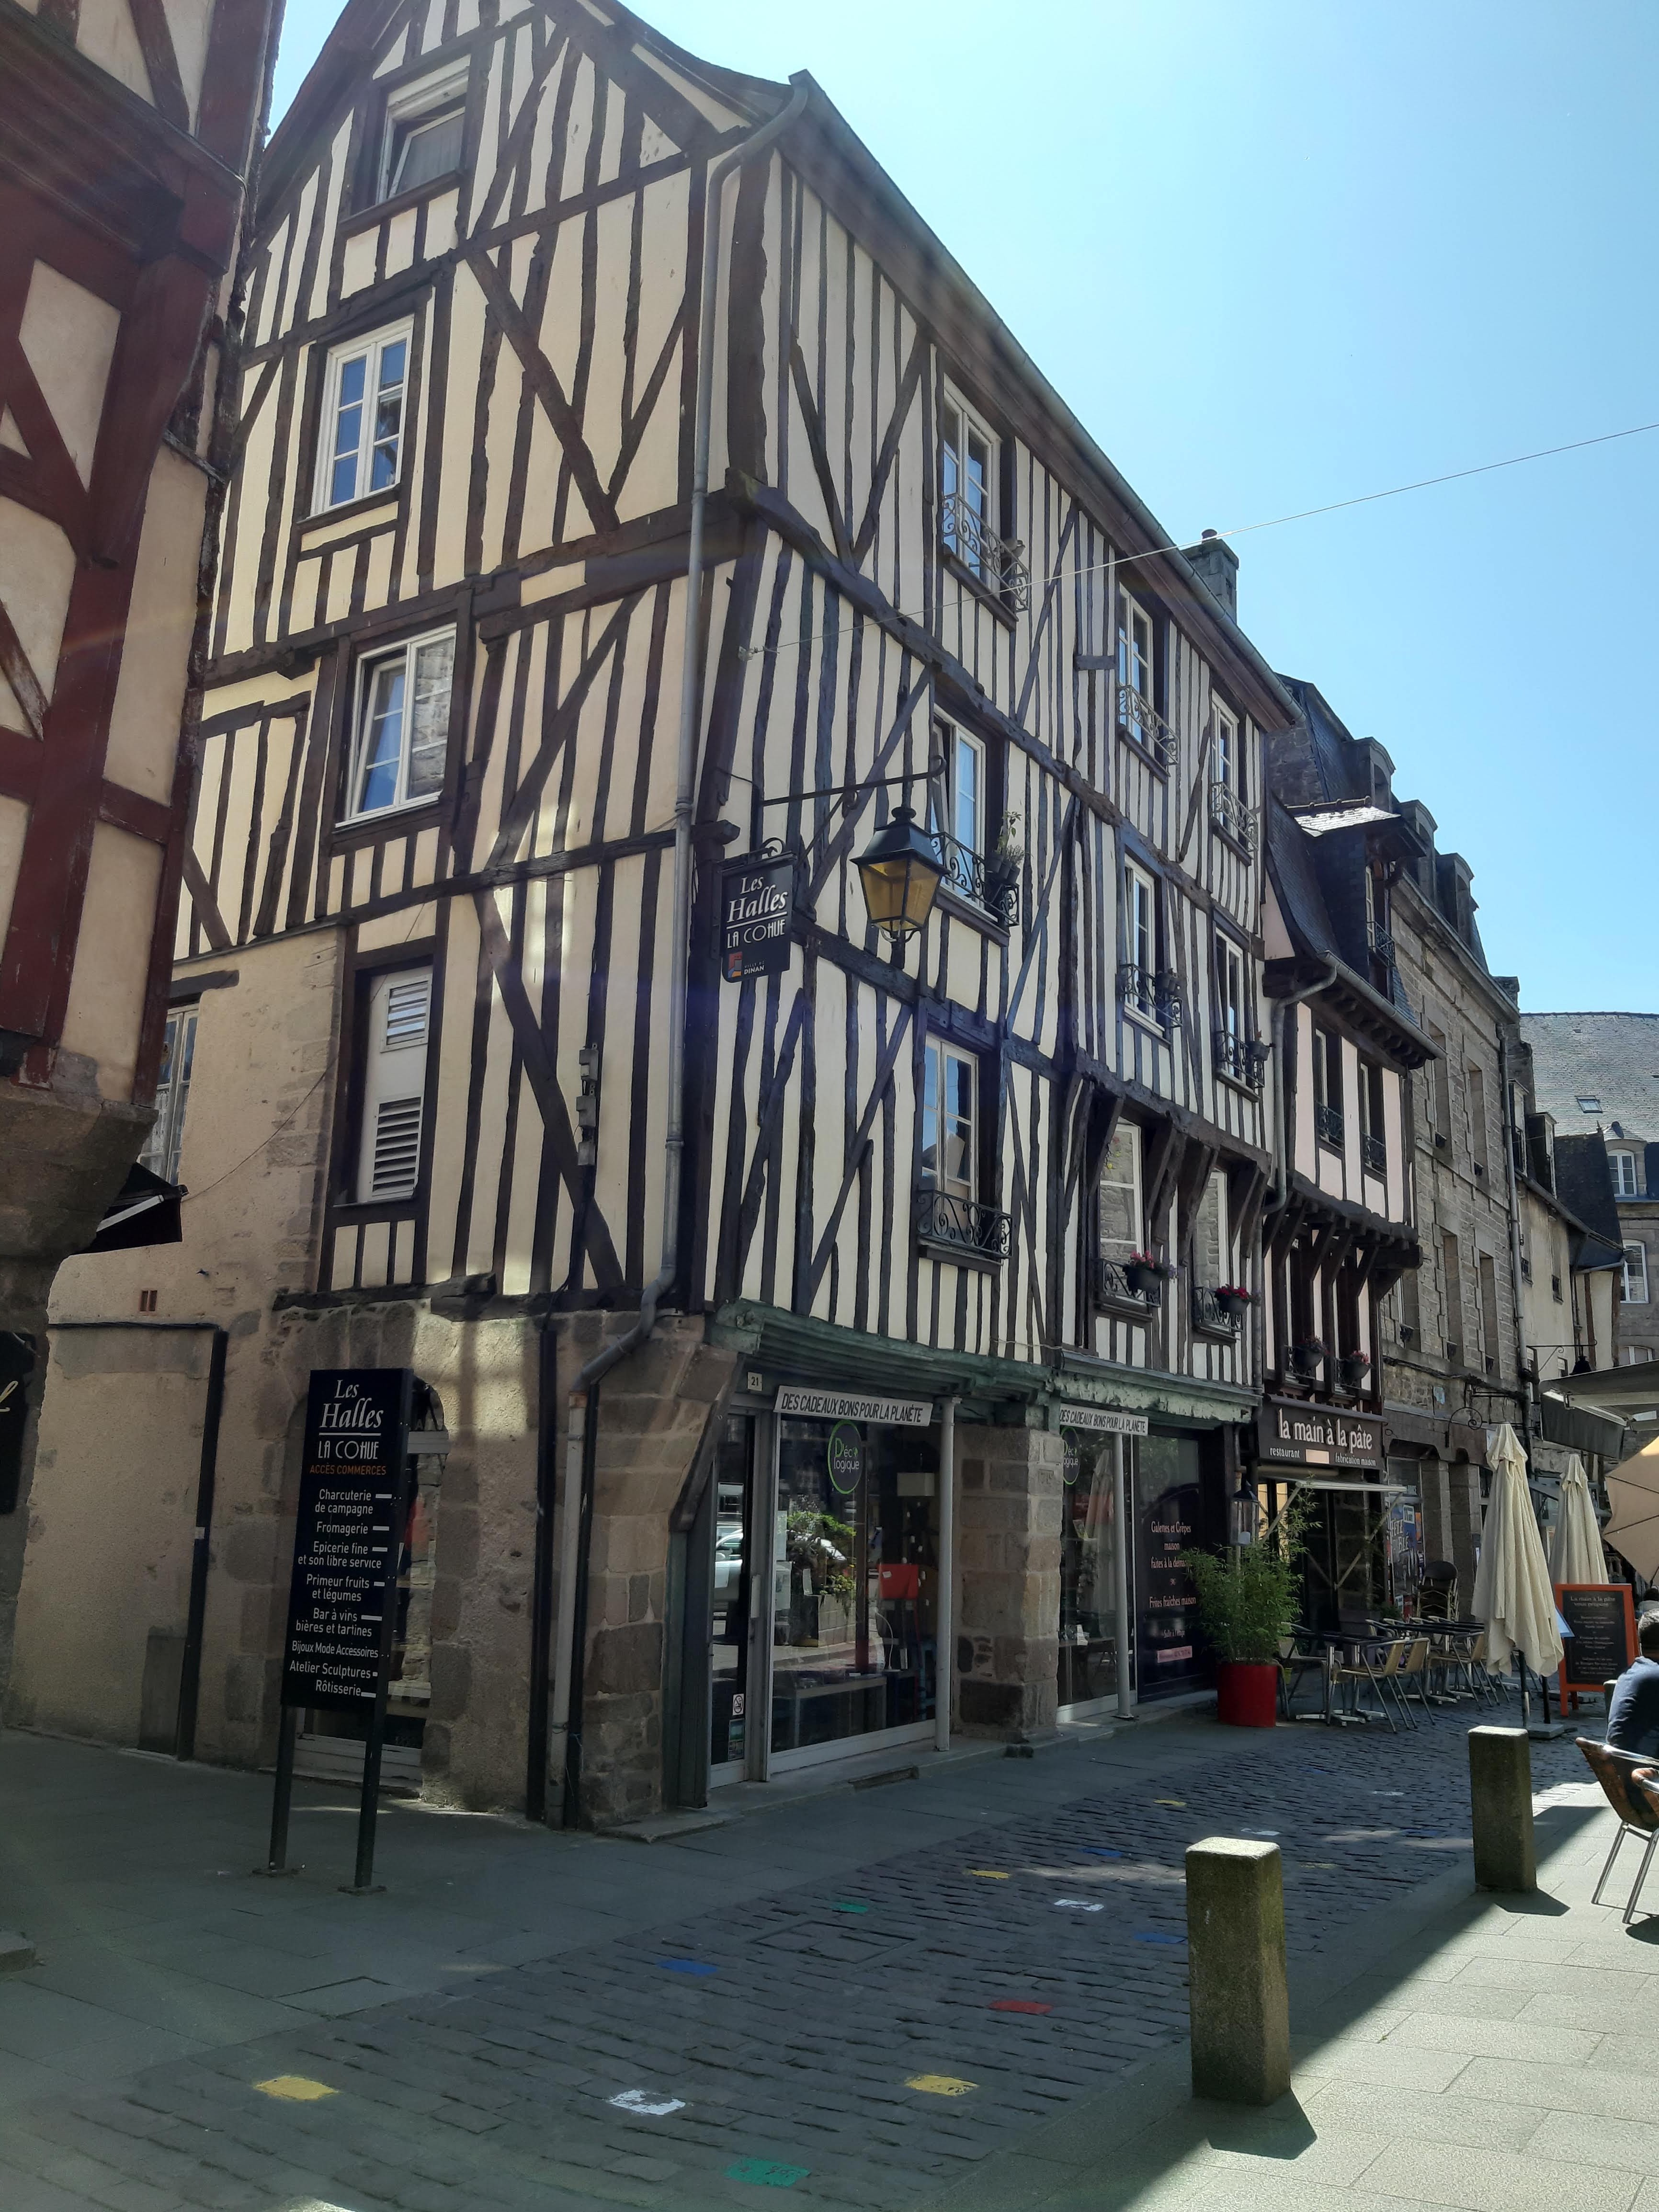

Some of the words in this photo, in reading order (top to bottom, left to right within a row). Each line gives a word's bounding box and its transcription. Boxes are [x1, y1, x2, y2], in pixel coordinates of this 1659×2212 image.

[740, 877, 763, 894] Les
[727, 884, 788, 923] Halles
[727, 931, 739, 949] LA
[744, 919, 785, 943] COHUE
[744, 965, 764, 975] DINAN
[751, 1376, 759, 1386] 21
[334, 1380, 359, 1398] Les
[318, 1397, 384, 1428] Halles
[781, 1393, 800, 1410] DES
[800, 1395, 838, 1414] CADEAUX
[838, 1399, 860, 1416] BONS
[859, 1402, 879, 1419] POUR
[879, 1404, 889, 1419] LA
[1060, 1409, 1070, 1422] DES
[1070, 1411, 1093, 1426] CADEAUX
[1093, 1414, 1106, 1427] BONS
[1106, 1416, 1119, 1429] POUR
[1118, 1417, 1125, 1430] LA
[1278, 1408, 1291, 1439] la
[1294, 1416, 1324, 1443] main
[1327, 1419, 1335, 1445] à
[1336, 1418, 1348, 1447] la
[1350, 1424, 1373, 1454] pâte
[318, 1440, 330, 1459] LA
[335, 1440, 379, 1459] COHUE
[1270, 1447, 1300, 1458] restaurant
[1335, 1452, 1360, 1464] fabrication
[1361, 1457, 1376, 1466] maison
[310, 1462, 335, 1474] ACCÈS
[337, 1465, 386, 1475] COMMERCES
[834, 1457, 860, 1473] logique
[1064, 1457, 1079, 1468] ogique
[319, 1489, 372, 1501] Charcuterie
[315, 1502, 325, 1513] de
[328, 1503, 373, 1516] campagne
[317, 1521, 368, 1536] Fromagerie
[1151, 1521, 1170, 1533] Galettes
[1176, 1521, 1191, 1535] Crêpes
[313, 1541, 349, 1554] Epicerie
[352, 1543, 368, 1554] fine
[1164, 1540, 1180, 1550] maison
[298, 1555, 307, 1565] et
[309, 1556, 324, 1565] son
[327, 1555, 347, 1567] libre
[350, 1557, 382, 1569] service
[1151, 1556, 1163, 1569] faites
[1164, 1557, 1167, 1568] à
[1168, 1556, 1172, 1568] la
[307, 1574, 343, 1587] Primeur
[345, 1575, 370, 1588] fruits
[312, 1589, 321, 1599] et
[323, 1588, 362, 1603] légumes
[1149, 1596, 1162, 1608] Frites
[1163, 1594, 1181, 1607] fraîches
[1181, 1594, 1196, 1605] maison
[313, 1608, 330, 1620] Bar
[331, 1608, 337, 1620] à
[339, 1609, 358, 1621] vins
[296, 1619, 323, 1633] bières
[326, 1624, 335, 1633] et
[338, 1624, 372, 1637] tartines
[292, 1640, 314, 1654] Bijoux
[315, 1642, 335, 1654] Mode
[336, 1644, 379, 1658] Accessoires
[289, 1660, 320, 1673] Atelier
[322, 1663, 371, 1679] Sculptures
[316, 1679, 361, 1696] Rôtisserie
